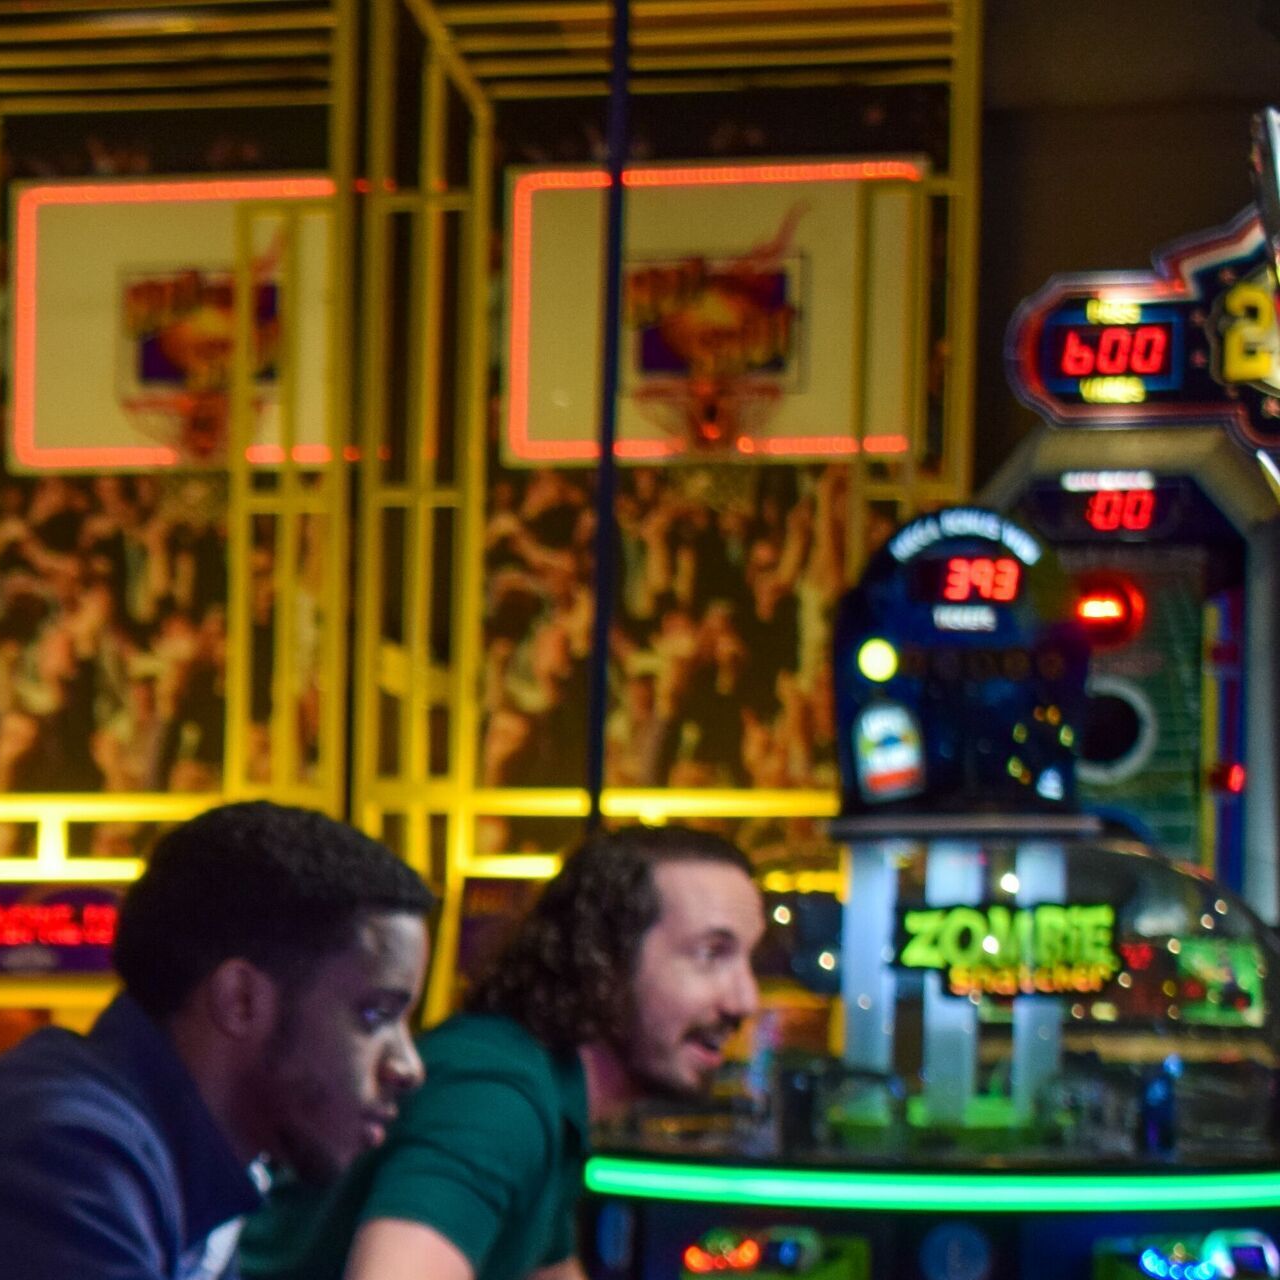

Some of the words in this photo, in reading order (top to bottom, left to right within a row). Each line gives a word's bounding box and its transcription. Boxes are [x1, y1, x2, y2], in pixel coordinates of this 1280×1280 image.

[1061, 326, 1167, 376] 600
[943, 556, 1020, 602] 393
[901, 904, 1117, 969] ZOMBIE
